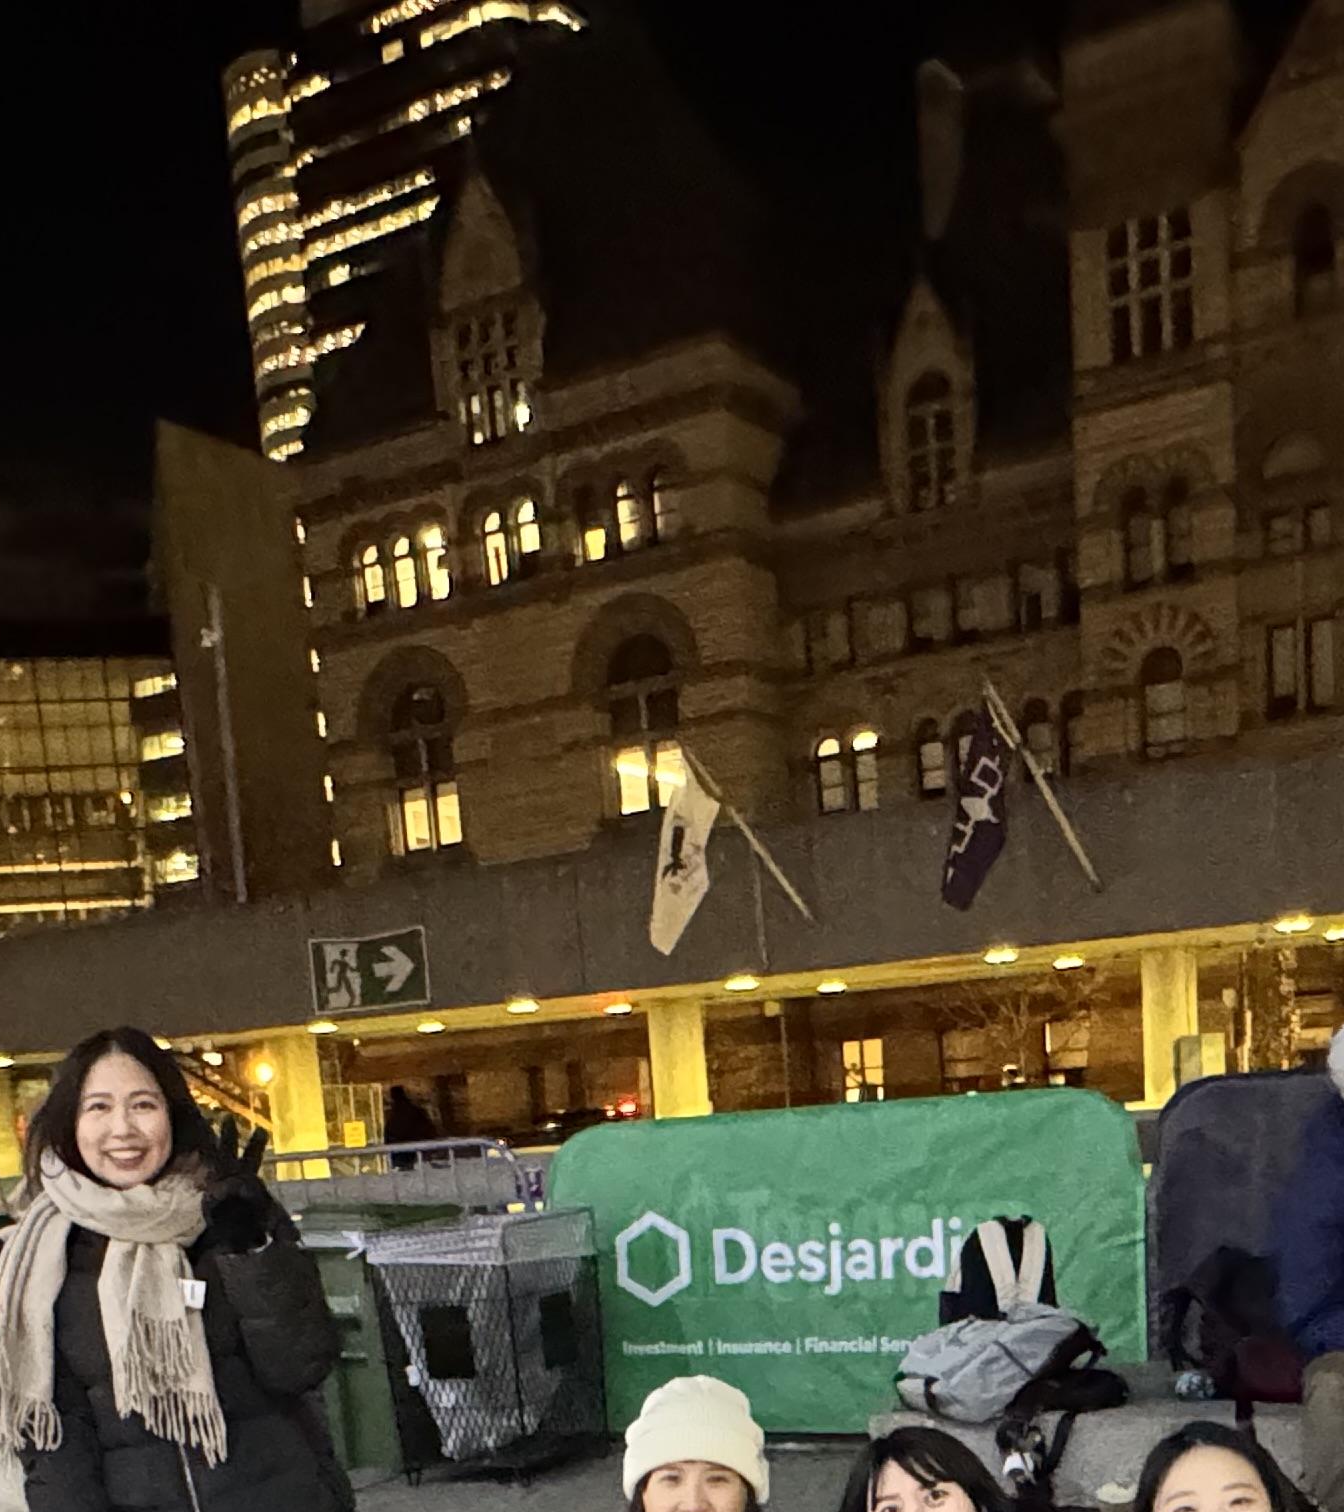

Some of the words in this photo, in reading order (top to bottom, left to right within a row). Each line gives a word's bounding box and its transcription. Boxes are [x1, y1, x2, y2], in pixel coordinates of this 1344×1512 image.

[712, 1216, 963, 1296] Desjardi
[622, 1339, 704, 1356] Investment
[717, 1338, 793, 1355] Insurance
[804, 1335, 877, 1354] Financial
